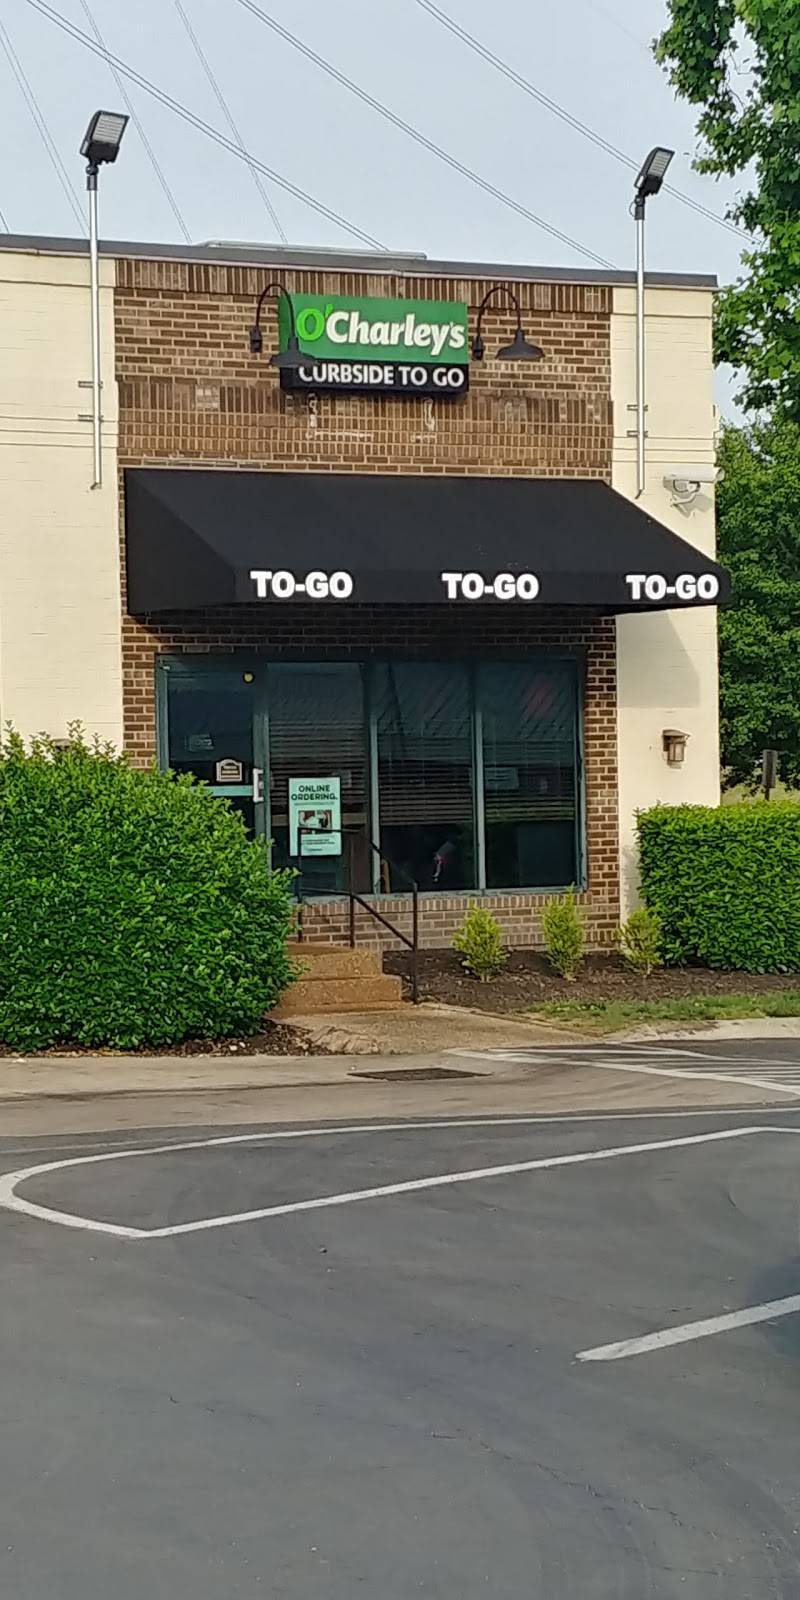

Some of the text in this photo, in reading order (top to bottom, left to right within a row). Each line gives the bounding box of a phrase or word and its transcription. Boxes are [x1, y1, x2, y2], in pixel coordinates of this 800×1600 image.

[296, 304, 465, 356] O'Charley's
[299, 363, 464, 387] CURBSIDE TO GO
[250, 571, 353, 598] TO-GO
[441, 573, 539, 600] TO-GO
[625, 574, 719, 600] TO-GO
[291, 793, 338, 801] ORDERING.
[298, 785, 331, 793] ONLINE
